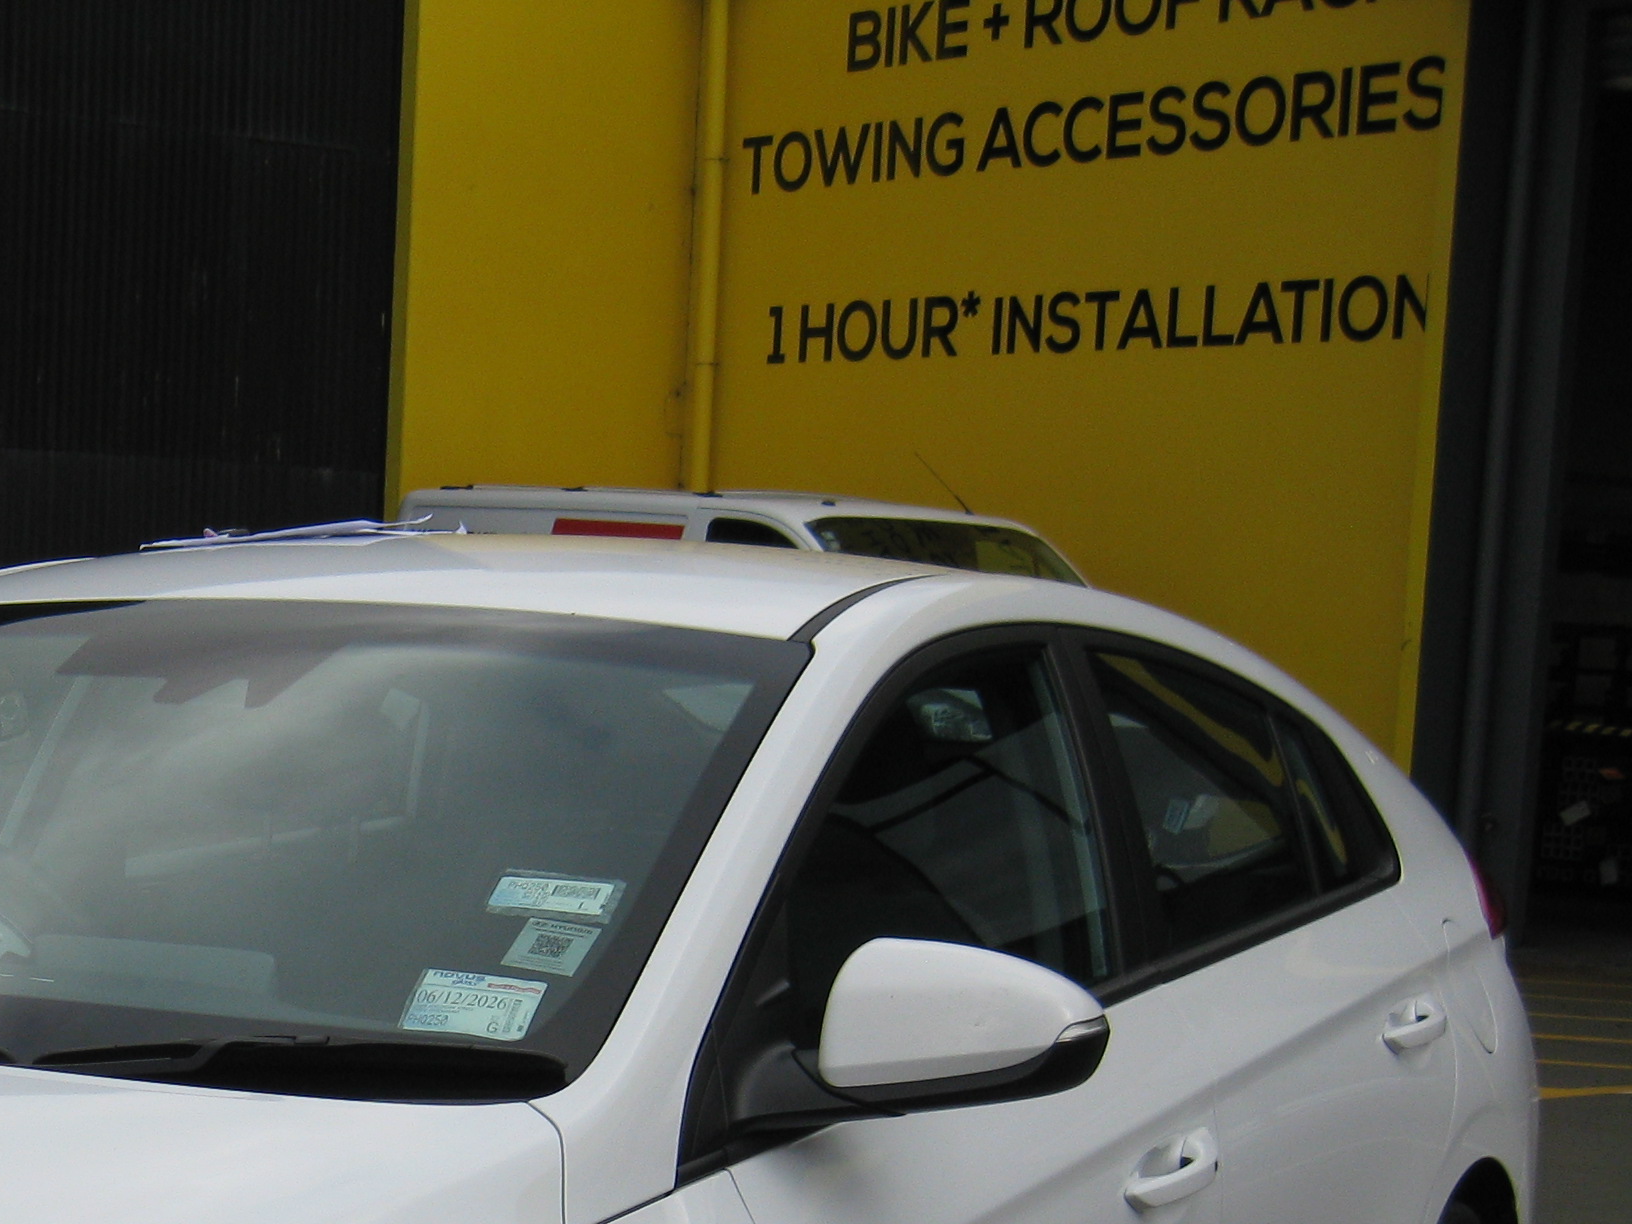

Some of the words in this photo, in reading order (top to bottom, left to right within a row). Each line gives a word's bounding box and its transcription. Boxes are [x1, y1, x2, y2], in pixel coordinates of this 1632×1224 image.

[846, 0, 969, 72] BIKE
[742, 112, 965, 195] TOWING
[976, 55, 1446, 172] ACCESSORIES
[767, 305, 785, 364] 1
[991, 273, 1430, 355] INSTALLATION
[417, 988, 508, 1011] 06/12/2026
